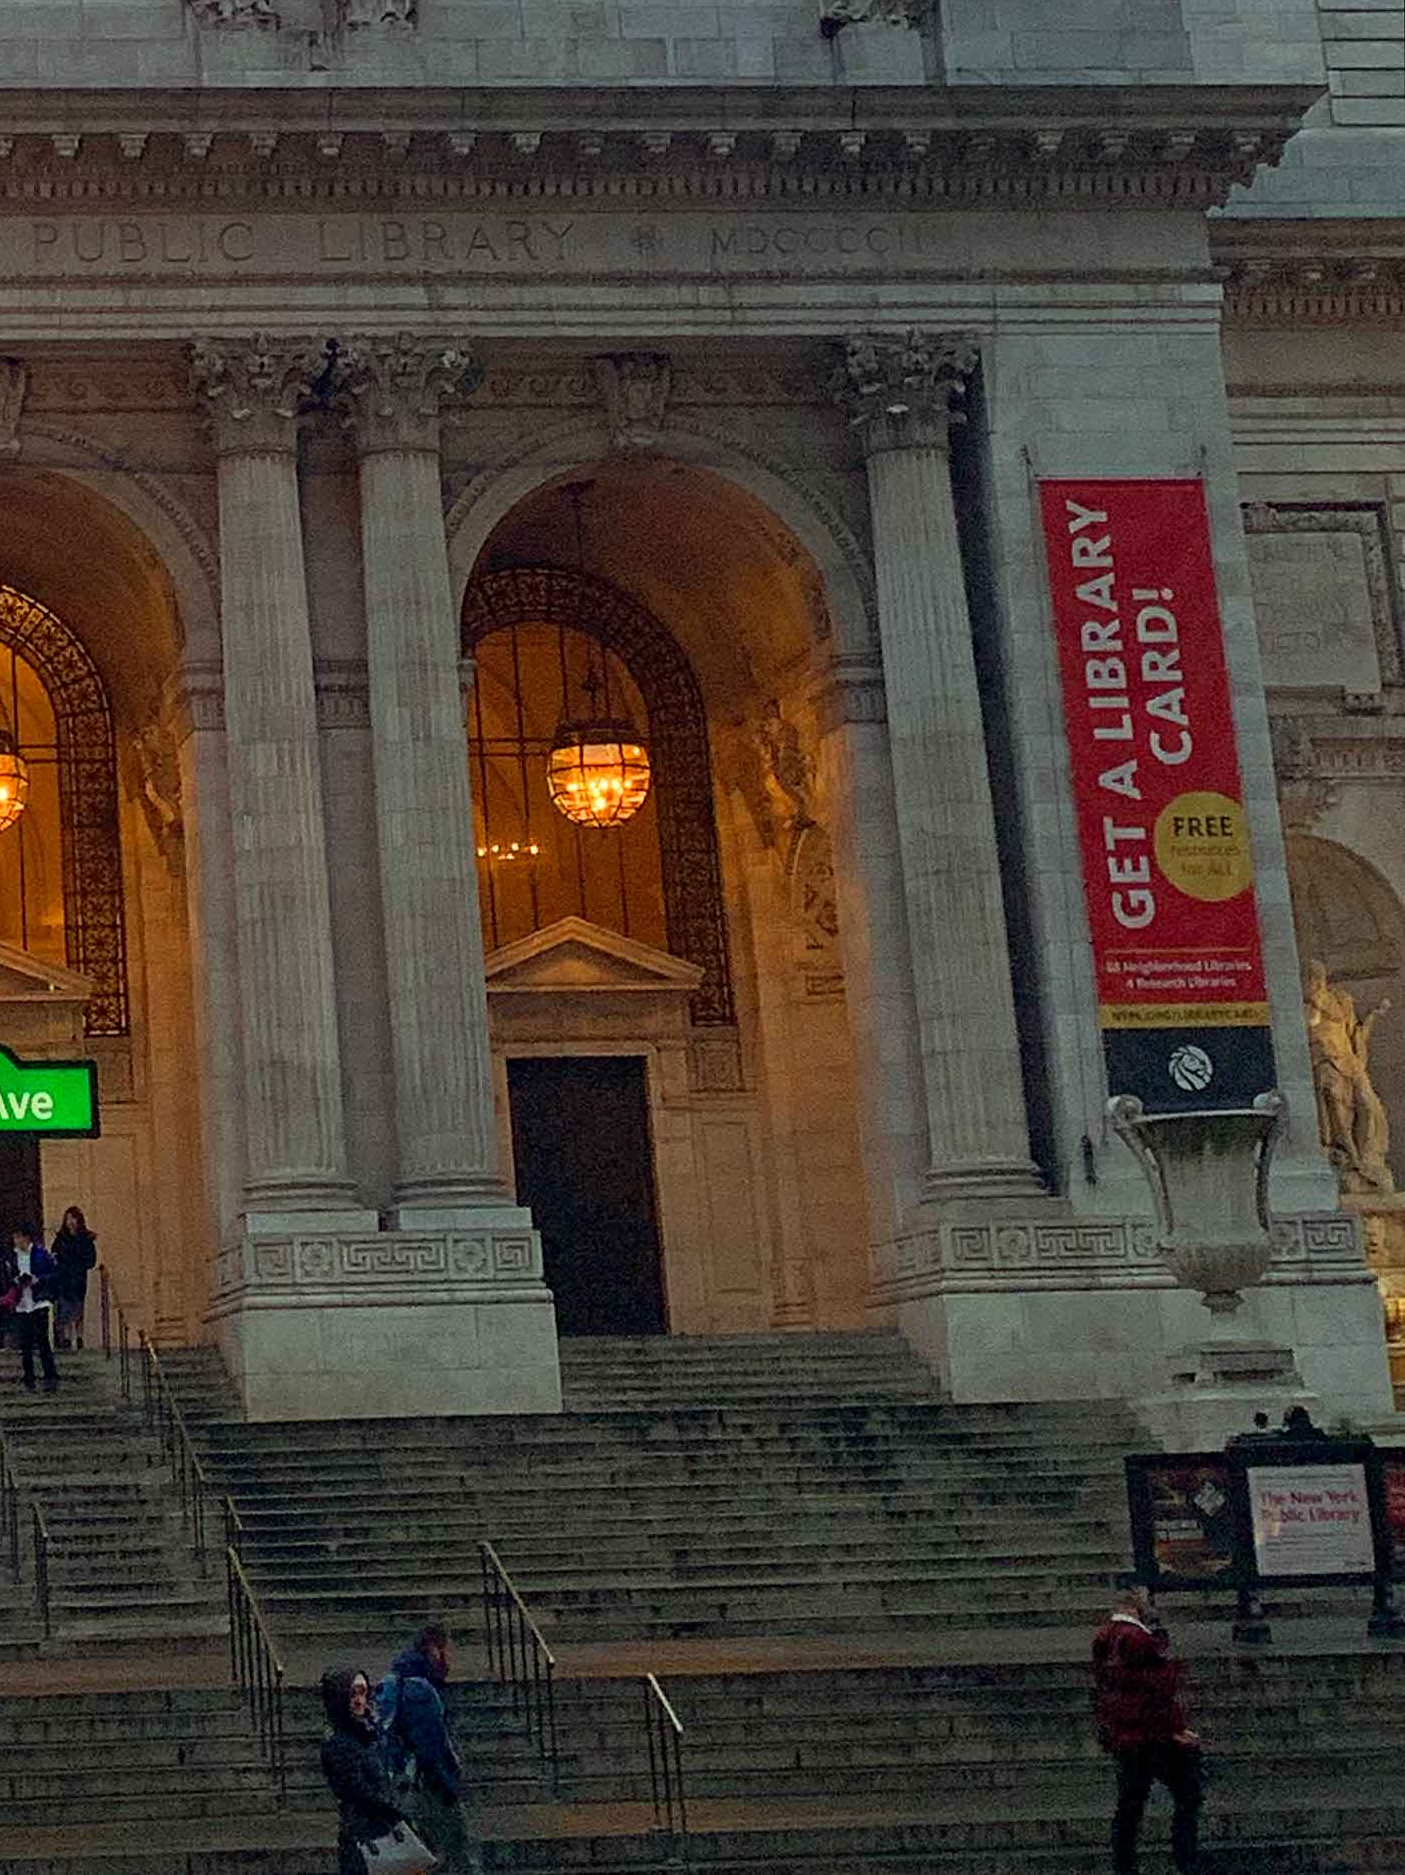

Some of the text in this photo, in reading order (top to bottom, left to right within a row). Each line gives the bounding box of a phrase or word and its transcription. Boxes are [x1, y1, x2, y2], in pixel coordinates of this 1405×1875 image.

[32, 222, 255, 264] PUBLIC
[316, 221, 575, 264] LIBRARY
[1131, 587, 1193, 765] CARD!
[1066, 499, 1156, 929] GET A LIBRARY
[1173, 815, 1235, 838] FREE
[1123, 960, 1202, 975] Neighborhood
